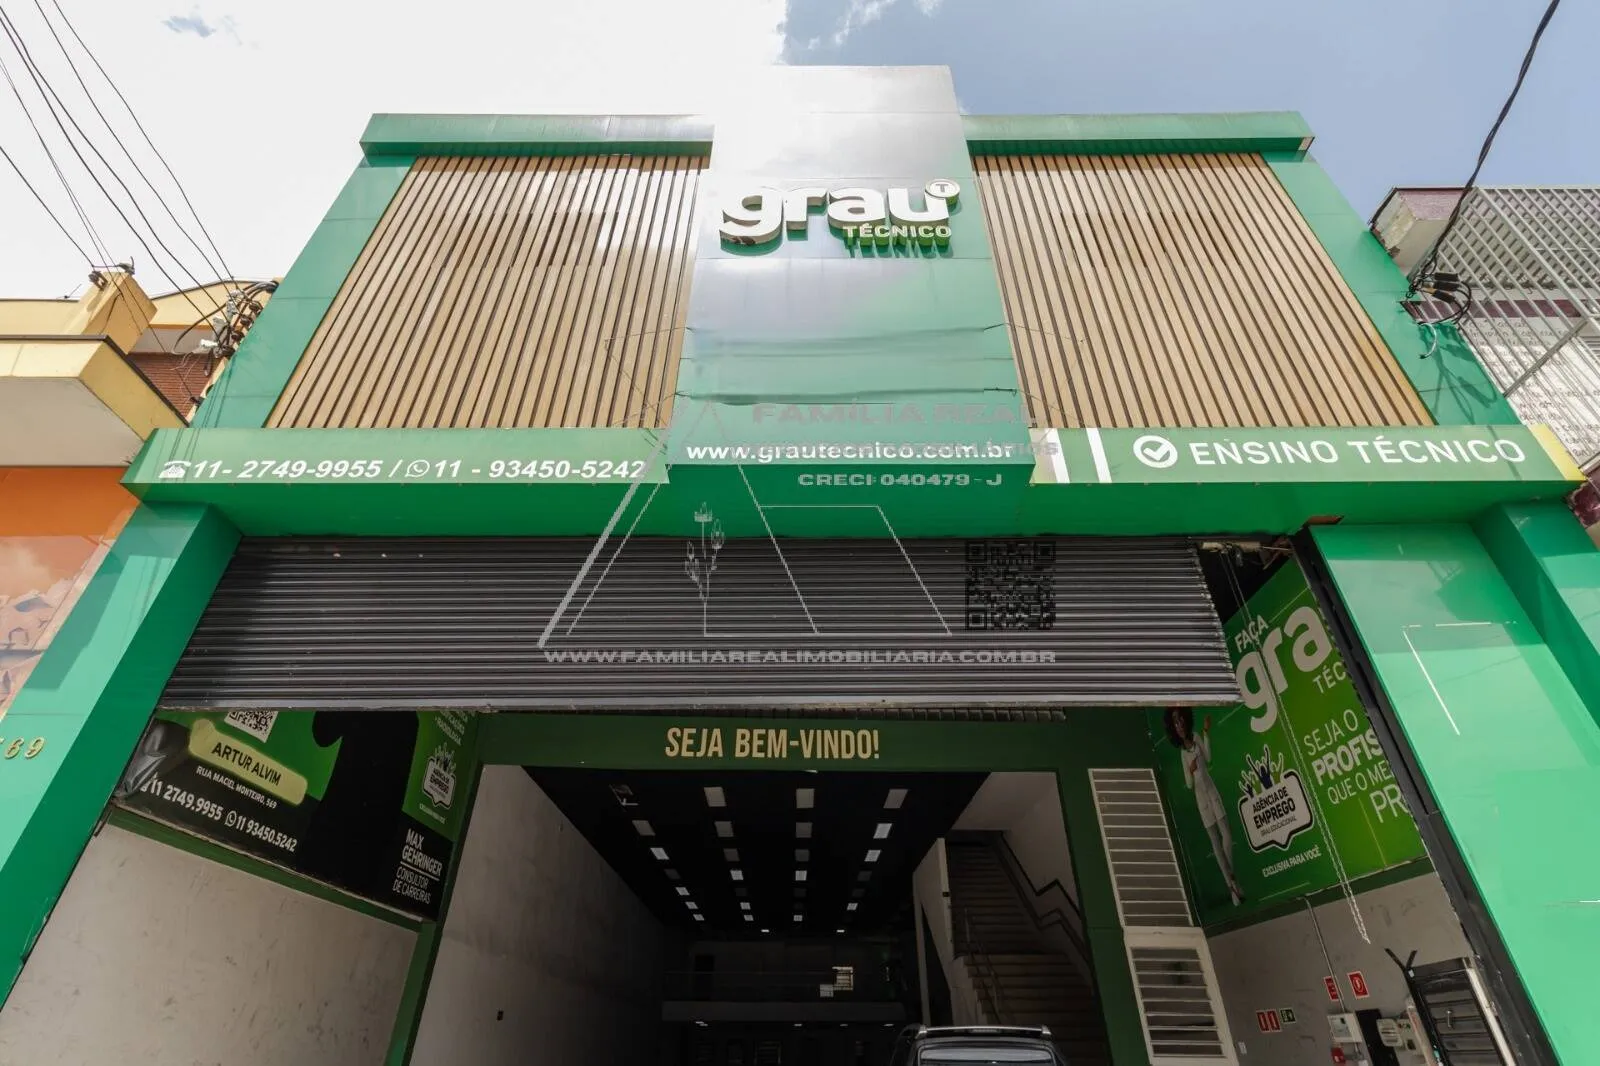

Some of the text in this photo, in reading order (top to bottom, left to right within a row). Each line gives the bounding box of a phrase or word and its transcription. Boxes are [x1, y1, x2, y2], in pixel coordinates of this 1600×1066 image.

[719, 186, 950, 245] grau
[843, 222, 952, 243] TÉCNICO
[685, 440, 1013, 464] www.grautecnico.com.br
[1188, 438, 1339, 466] ENSINO
[1347, 434, 1526, 463] TÉCNICO
[237, 459, 384, 478] 2749-9955
[434, 459, 463, 478] 11
[488, 459, 647, 478] 93450-5242
[1234, 614, 1269, 654] FAÇA
[1312, 661, 1347, 694] TÉC
[0, 736, 46, 759] 69
[665, 727, 880, 759] SEJA BEM-VINDO!
[1303, 708, 1359, 756] SEJA O
[211, 742, 282, 787] ARTUR ALVIM
[195, 765, 212, 779] RUA
[212, 772, 236, 790] MACIEL
[235, 781, 266, 805] MONTEIRO,
[1327, 760, 1394, 805] QUE O ME
[150, 777, 298, 852] 11 2749.9955 11 93450.5242
[1252, 786, 1289, 813] AGÊNCIA DE
[1253, 797, 1296, 829] EMPREGO
[405, 828, 425, 850] MAX
[401, 844, 443, 877] GEHRINGER
[392, 879, 432, 905] DE CARREIRAS
[396, 866, 430, 890] CONSULTOR
